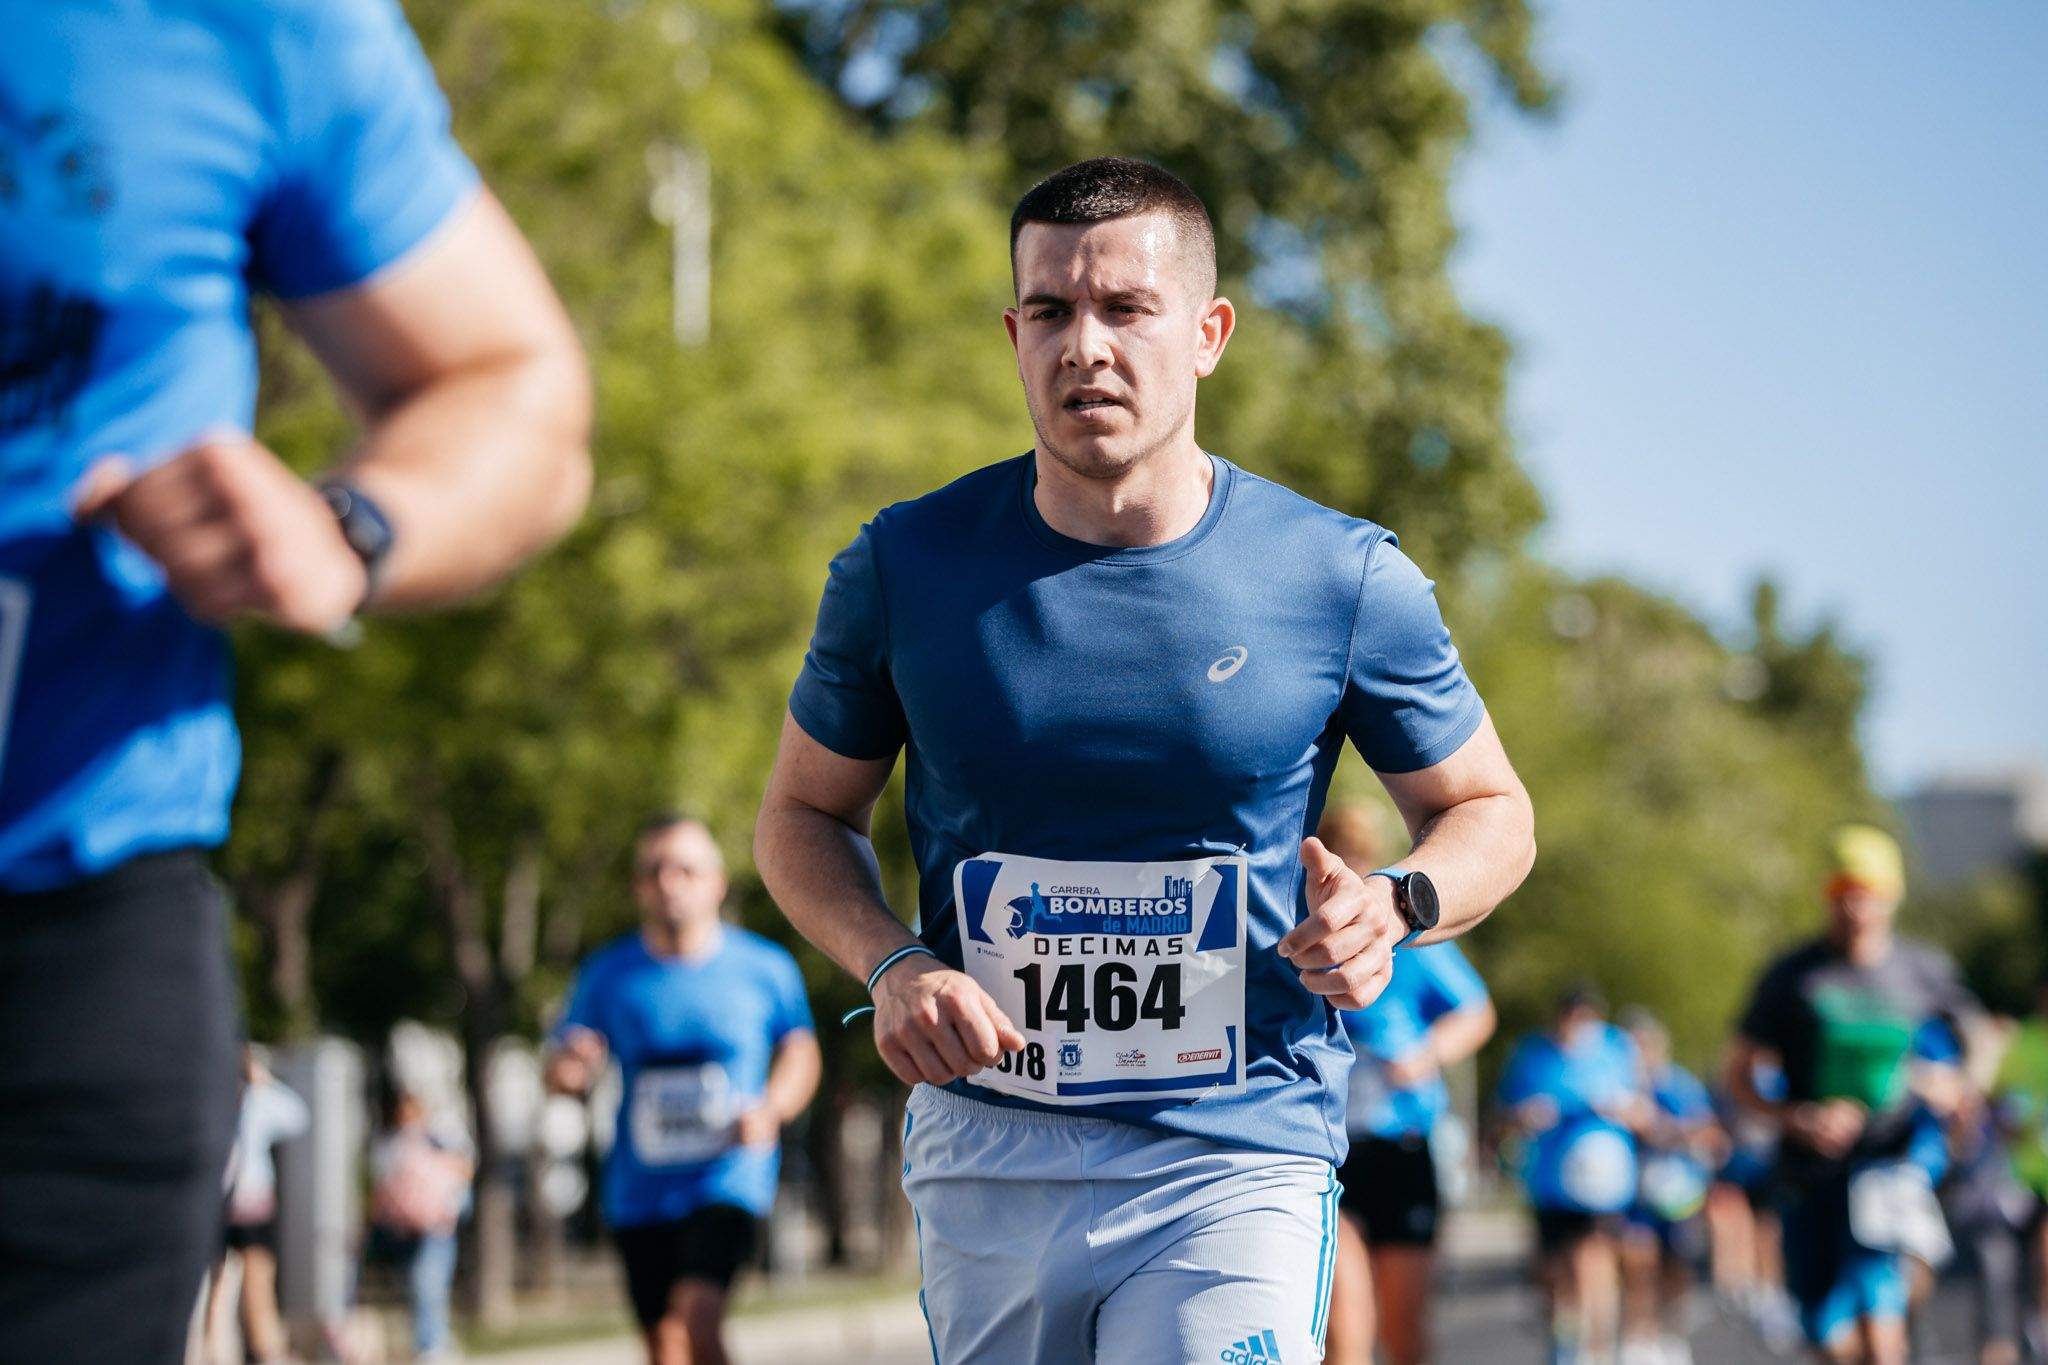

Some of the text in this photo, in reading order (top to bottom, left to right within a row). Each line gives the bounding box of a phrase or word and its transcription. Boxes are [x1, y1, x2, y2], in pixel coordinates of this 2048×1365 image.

[1050, 885, 1101, 895] CARRERA
[1050, 897, 1187, 916] BOMBEROS
[1102, 914, 1188, 934] de MADRID
[1034, 937, 1183, 956] DECIMAS
[1013, 962, 1186, 1033] 1464
[1190, 1050, 1220, 1061] ENERVIT
